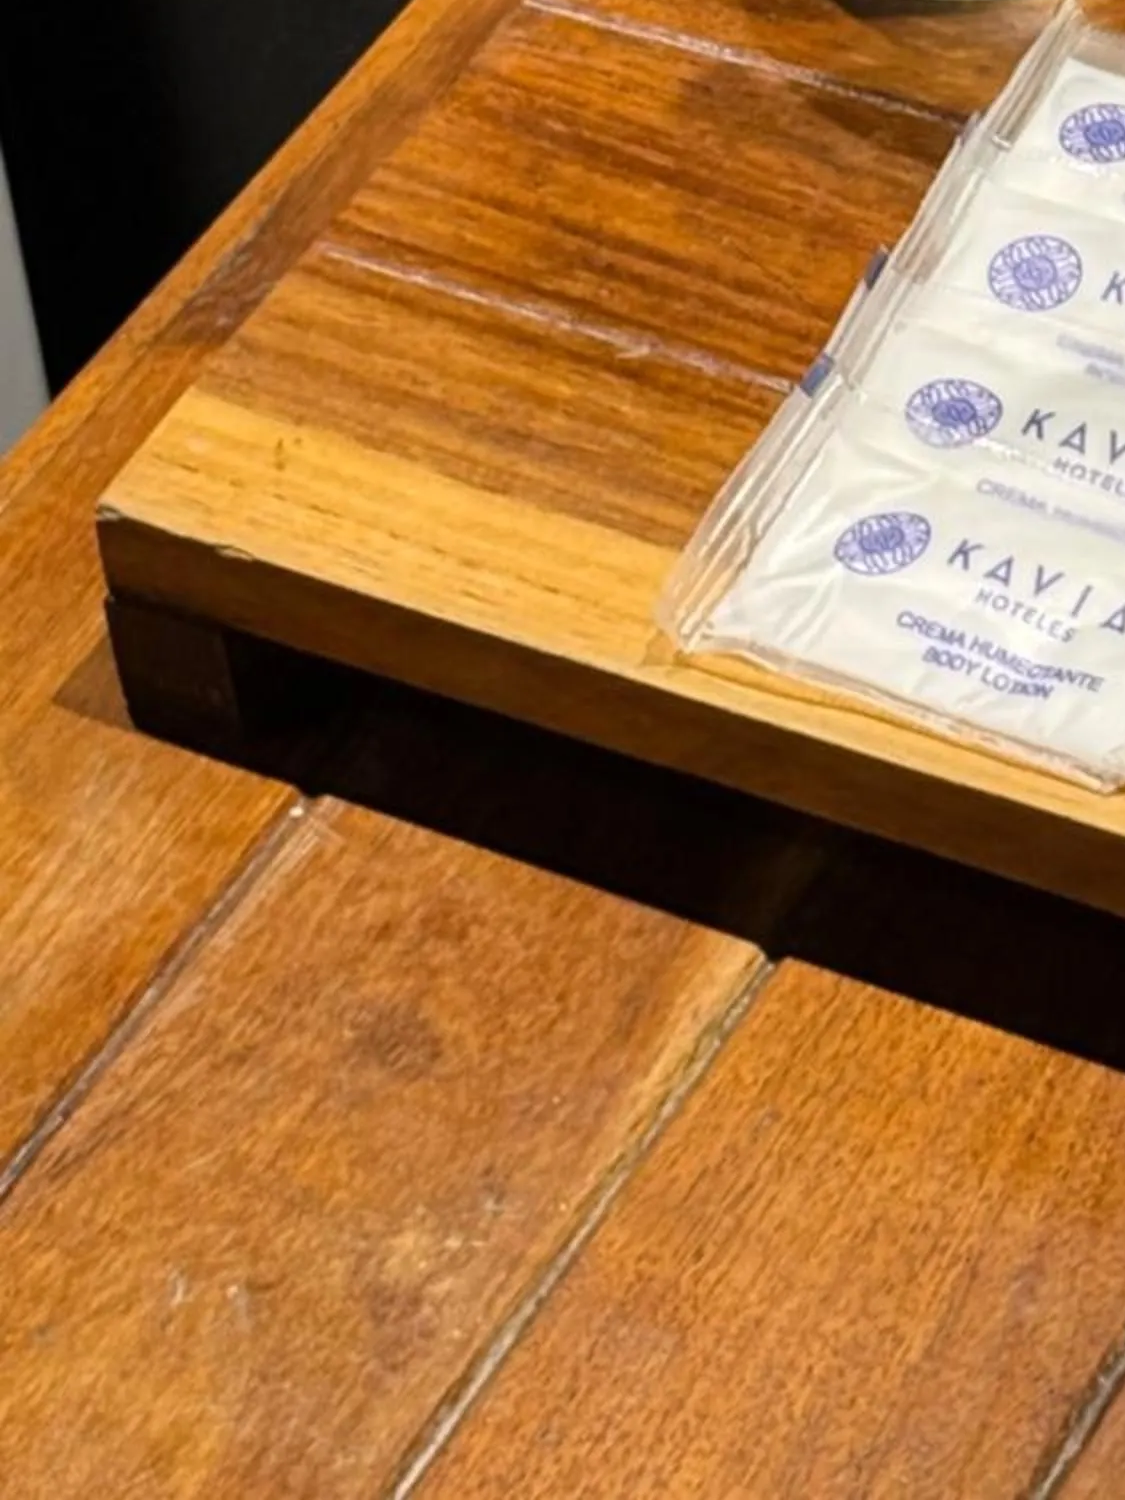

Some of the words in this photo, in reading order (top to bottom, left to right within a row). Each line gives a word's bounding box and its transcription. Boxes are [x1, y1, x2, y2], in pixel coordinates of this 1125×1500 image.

[896, 610, 966, 648] CREMA
[975, 586, 1078, 644] HOTELES
[921, 645, 981, 676] BODY
